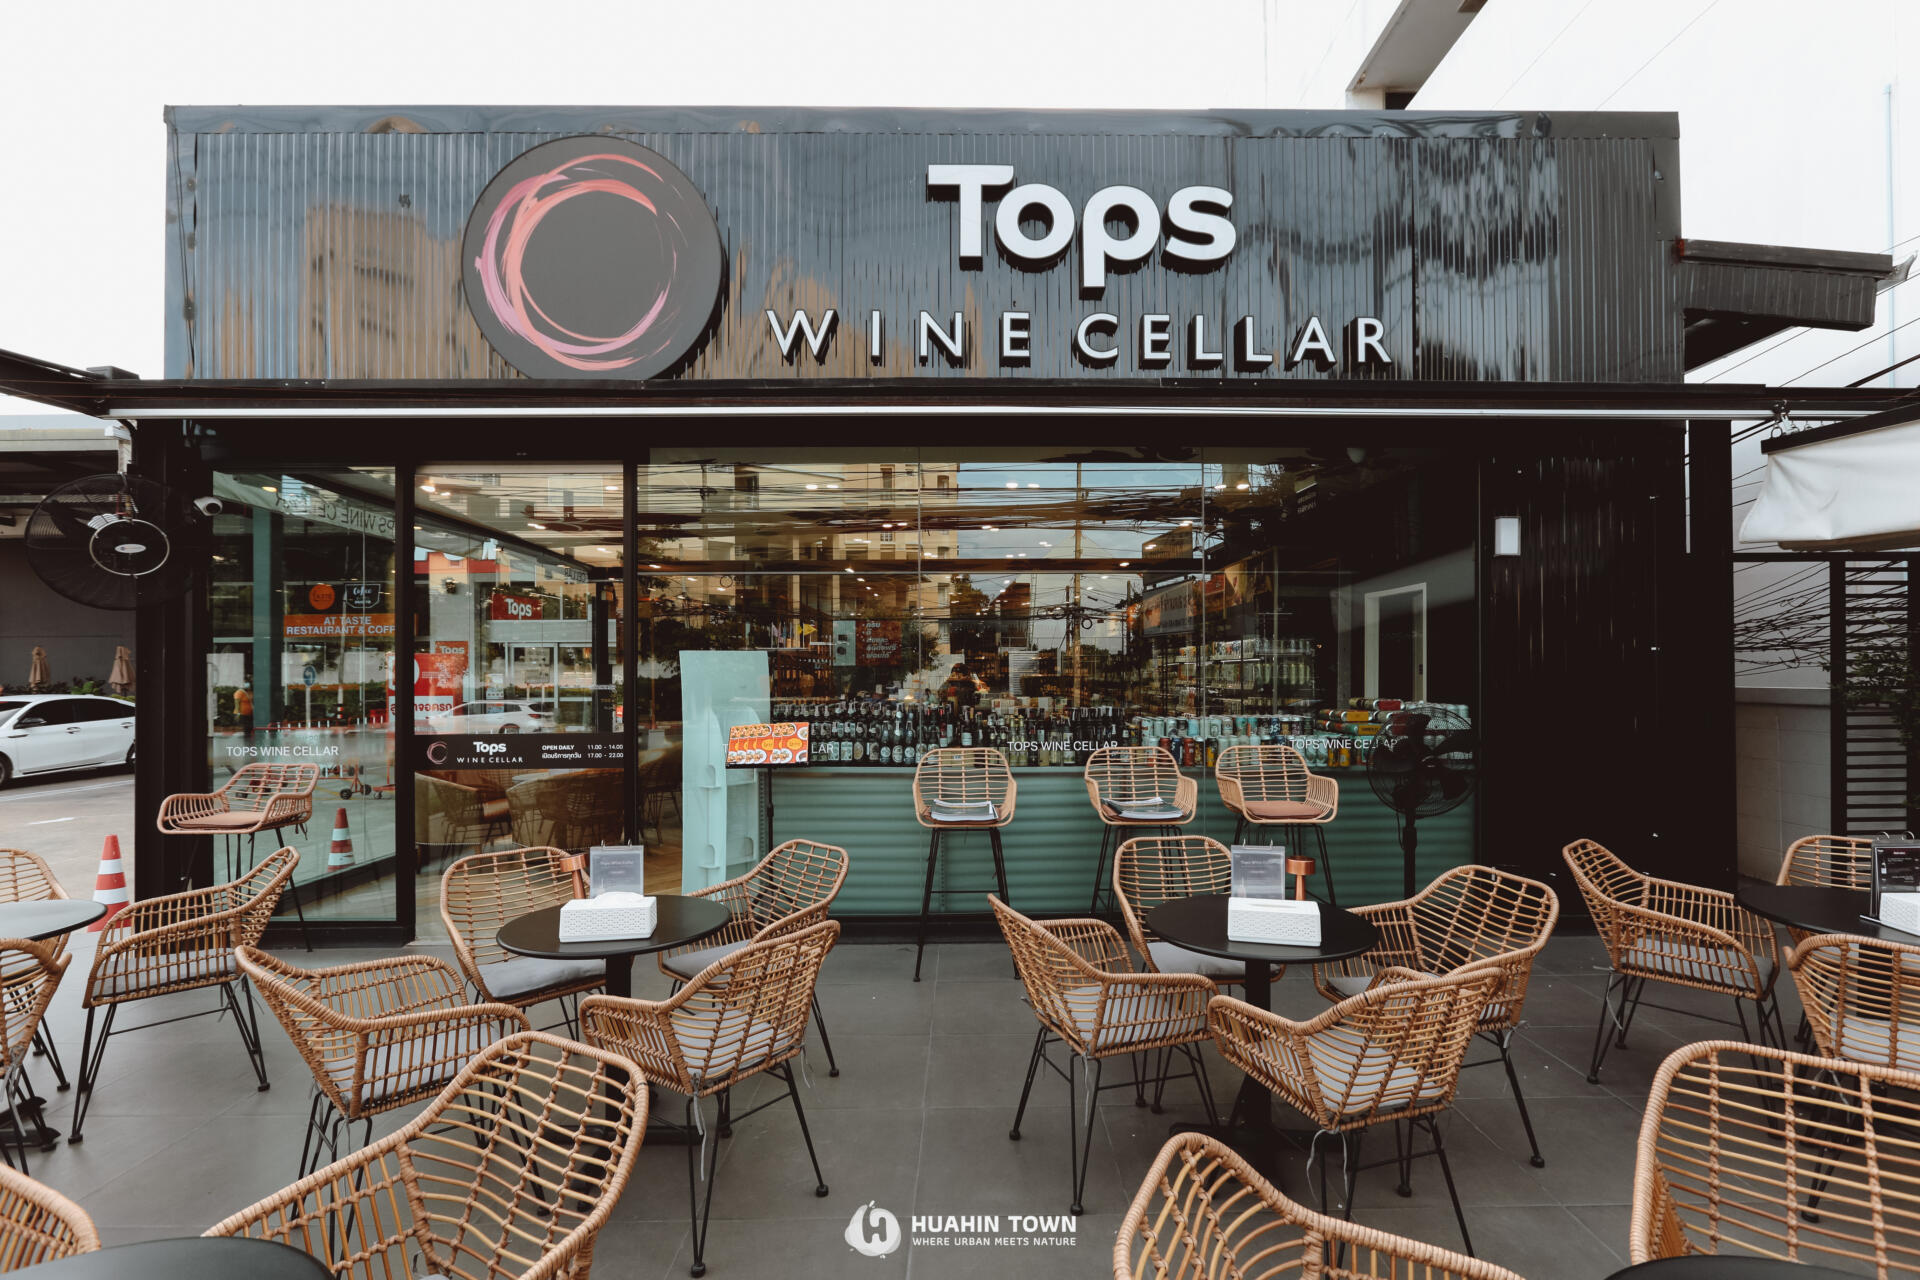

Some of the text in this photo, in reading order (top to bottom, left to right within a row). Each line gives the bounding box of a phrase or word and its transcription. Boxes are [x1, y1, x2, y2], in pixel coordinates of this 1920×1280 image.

[927, 163, 1237, 291] Tops
[765, 307, 1393, 365] WINE CELLAR
[504, 598, 532, 620] Tops
[324, 616, 372, 625] AT TASTE
[286, 625, 357, 635] RESTAURANT
[367, 625, 396, 634] COFF
[473, 741, 507, 755] Tops
[1007, 741, 1038, 751] TOPS
[1041, 740, 1071, 751] WINE
[1289, 739, 1320, 749] TOPS
[1322, 739, 1352, 749] WINE
[226, 745, 339, 757] TOPS WINE CELLAR
